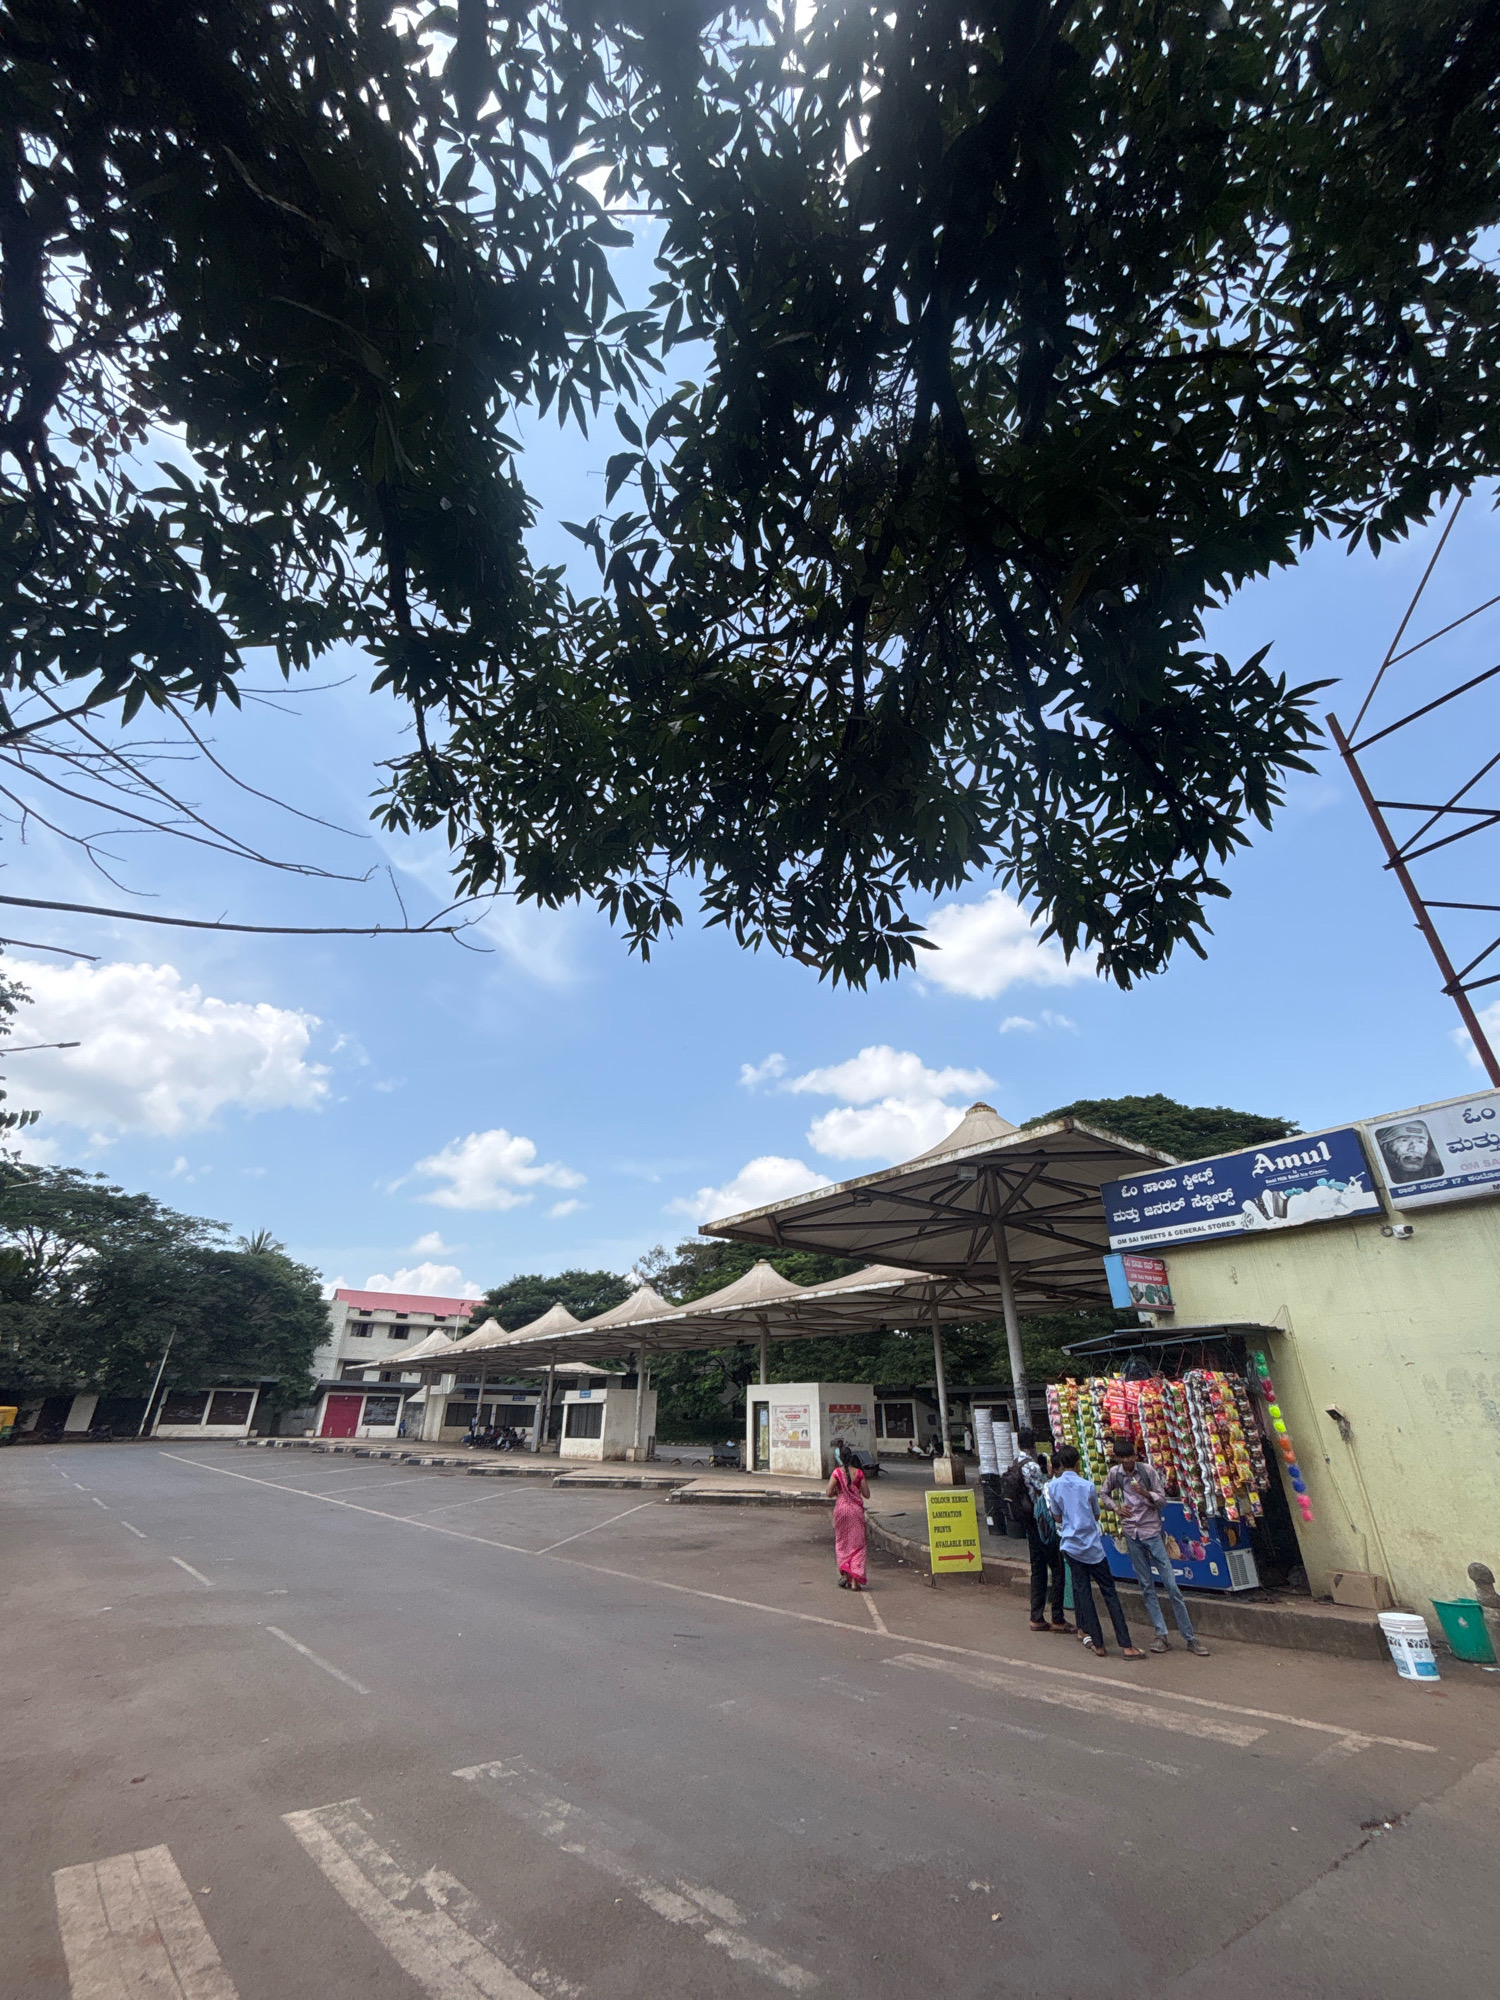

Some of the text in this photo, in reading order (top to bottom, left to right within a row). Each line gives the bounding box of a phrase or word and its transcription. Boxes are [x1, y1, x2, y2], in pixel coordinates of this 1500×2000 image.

[1462, 1107, 1496, 1124] ಓಂ
[1252, 1141, 1332, 1178] Amul
[1460, 1159, 1500, 1171] OM SA
[1121, 1185, 1138, 1198] ಓಂ
[1143, 1178, 1177, 1194] ಸಾಯಿ
[1128, 1236, 1139, 1244] SAI
[1140, 1232, 1166, 1242] SWEETS
[1175, 1225, 1206, 1236] GENERAL
[1207, 1220, 1236, 1231] STORES
[931, 1496, 950, 1504] COLOUR
[932, 1510, 962, 1518] LAMINATION
[934, 1525, 951, 1533] PRINTS
[935, 1540, 962, 1548] AVAILABLE
